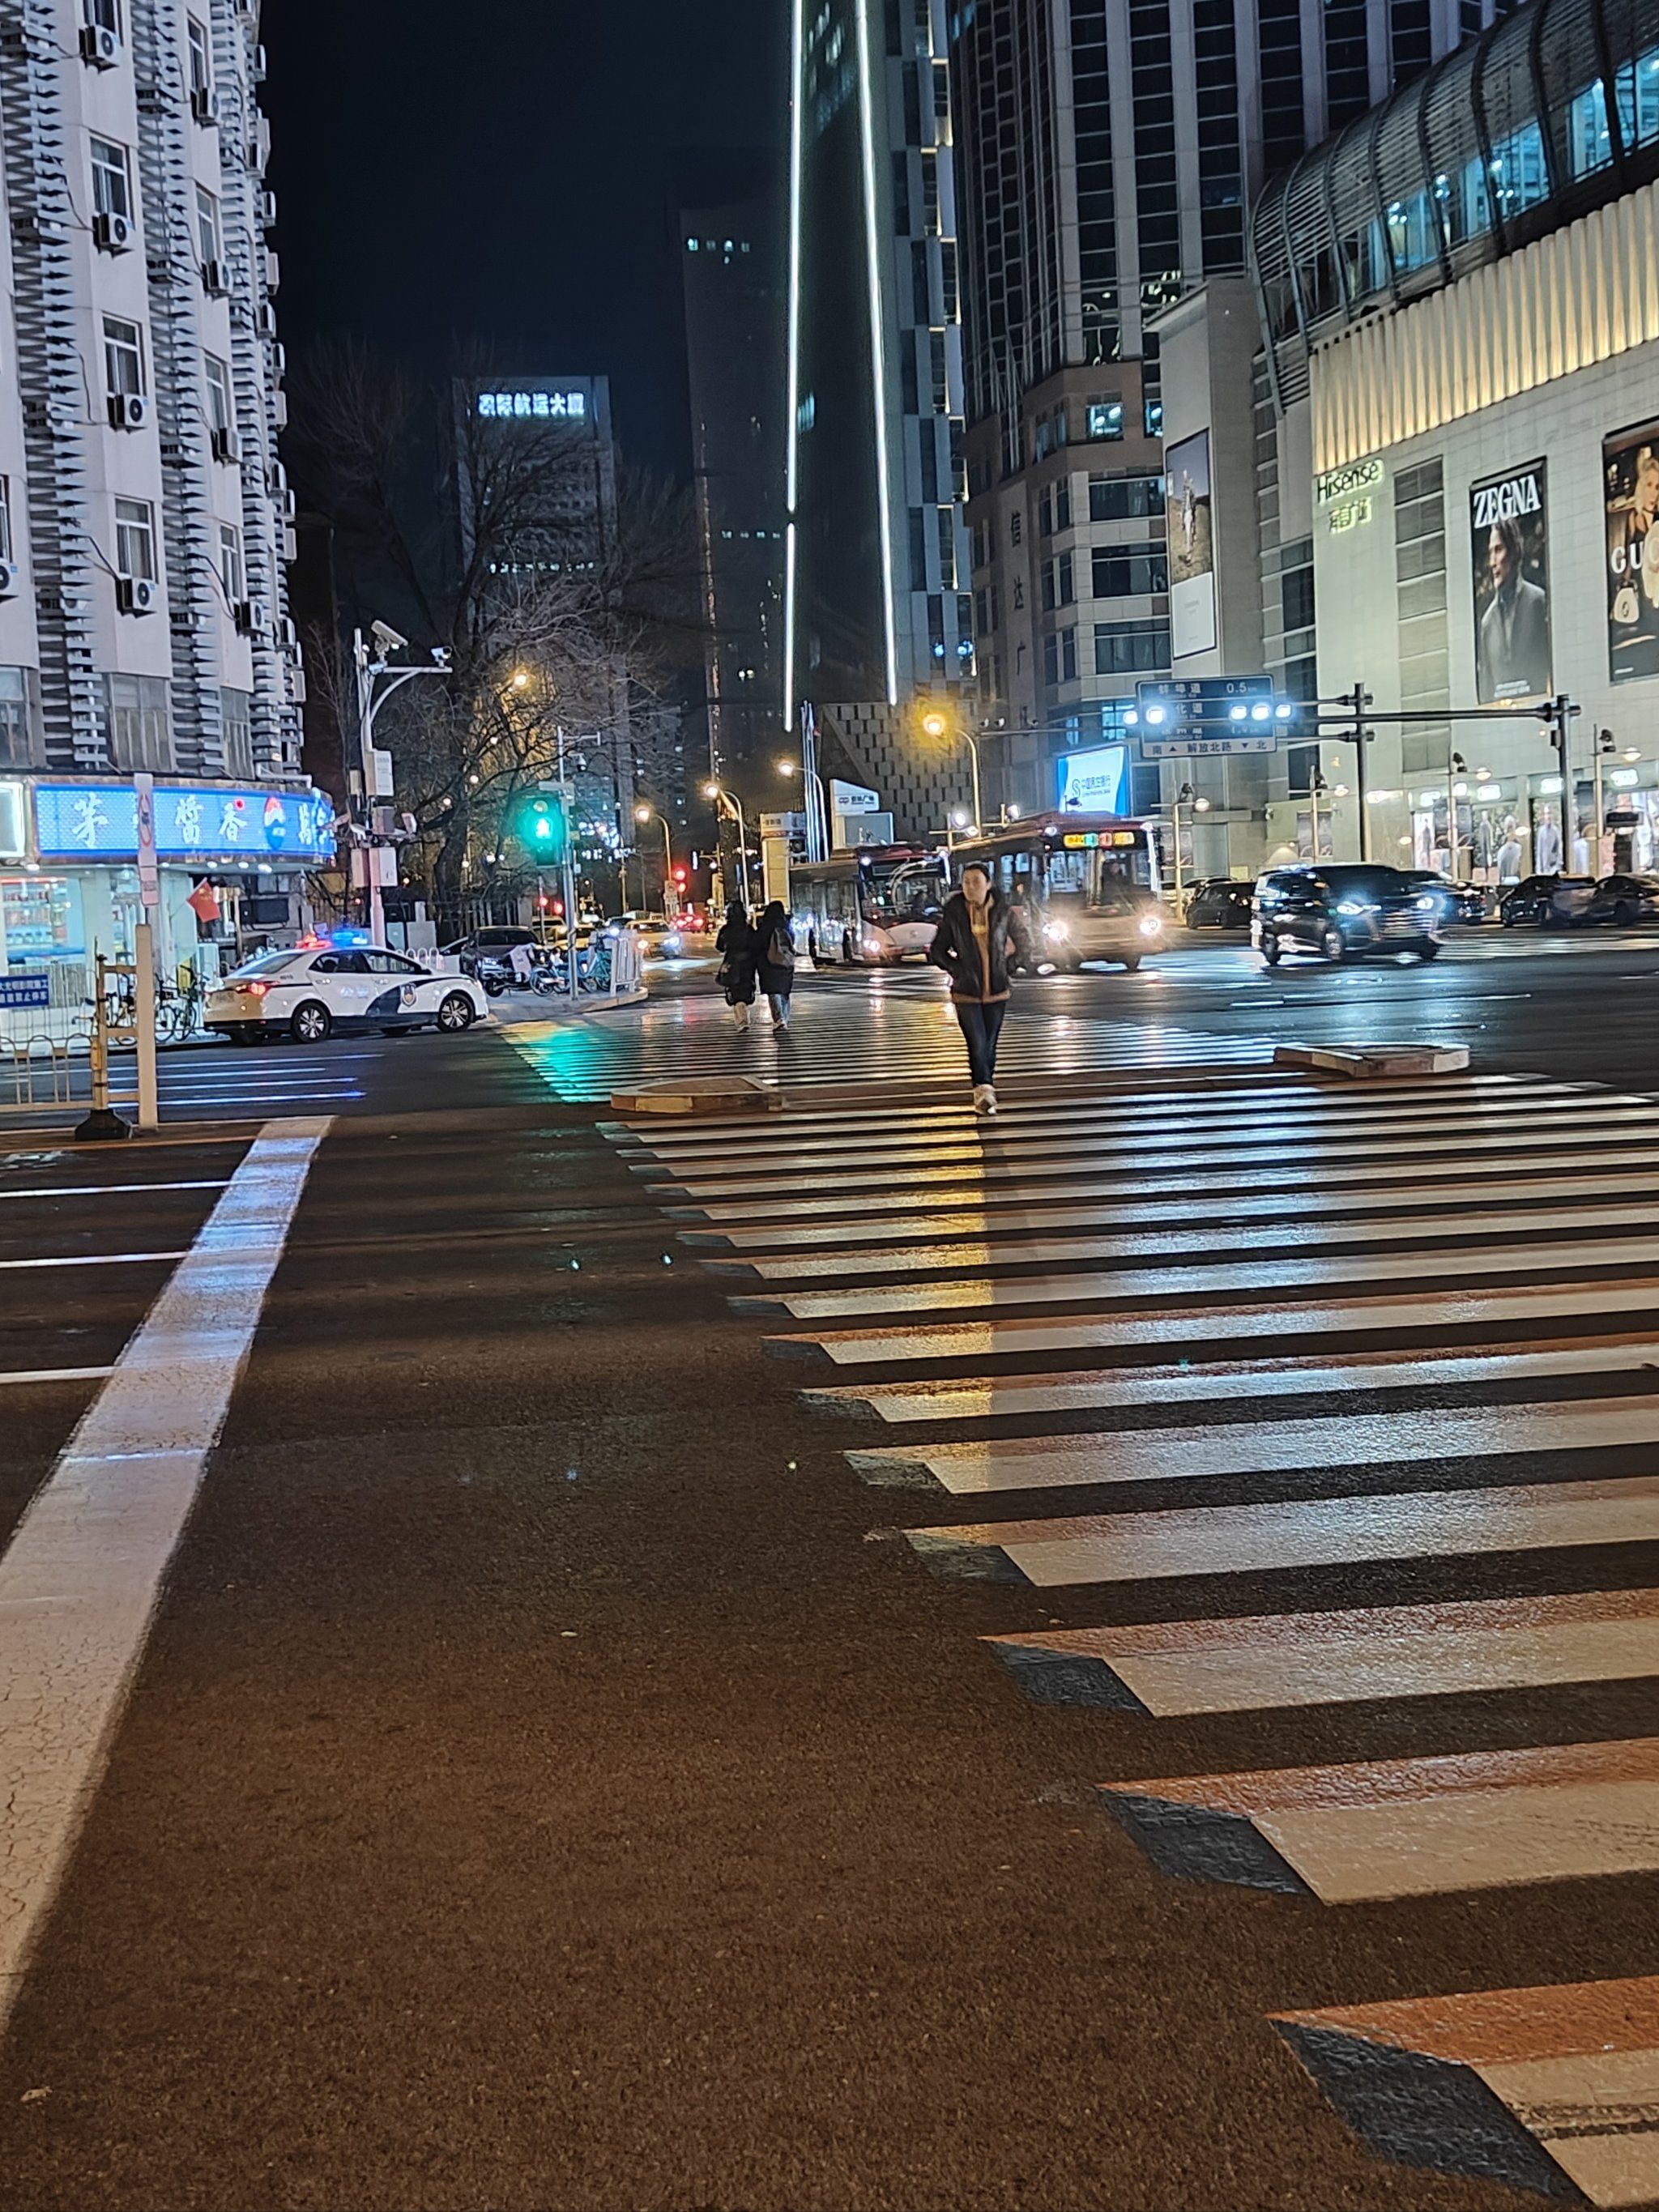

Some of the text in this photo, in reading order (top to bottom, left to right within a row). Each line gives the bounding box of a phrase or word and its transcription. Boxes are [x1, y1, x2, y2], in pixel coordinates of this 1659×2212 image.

[1316, 461, 1380, 504] Hisense
[1473, 475, 1542, 529] ZEGNA
[1153, 739, 1267, 755] 南 解放北路 北
